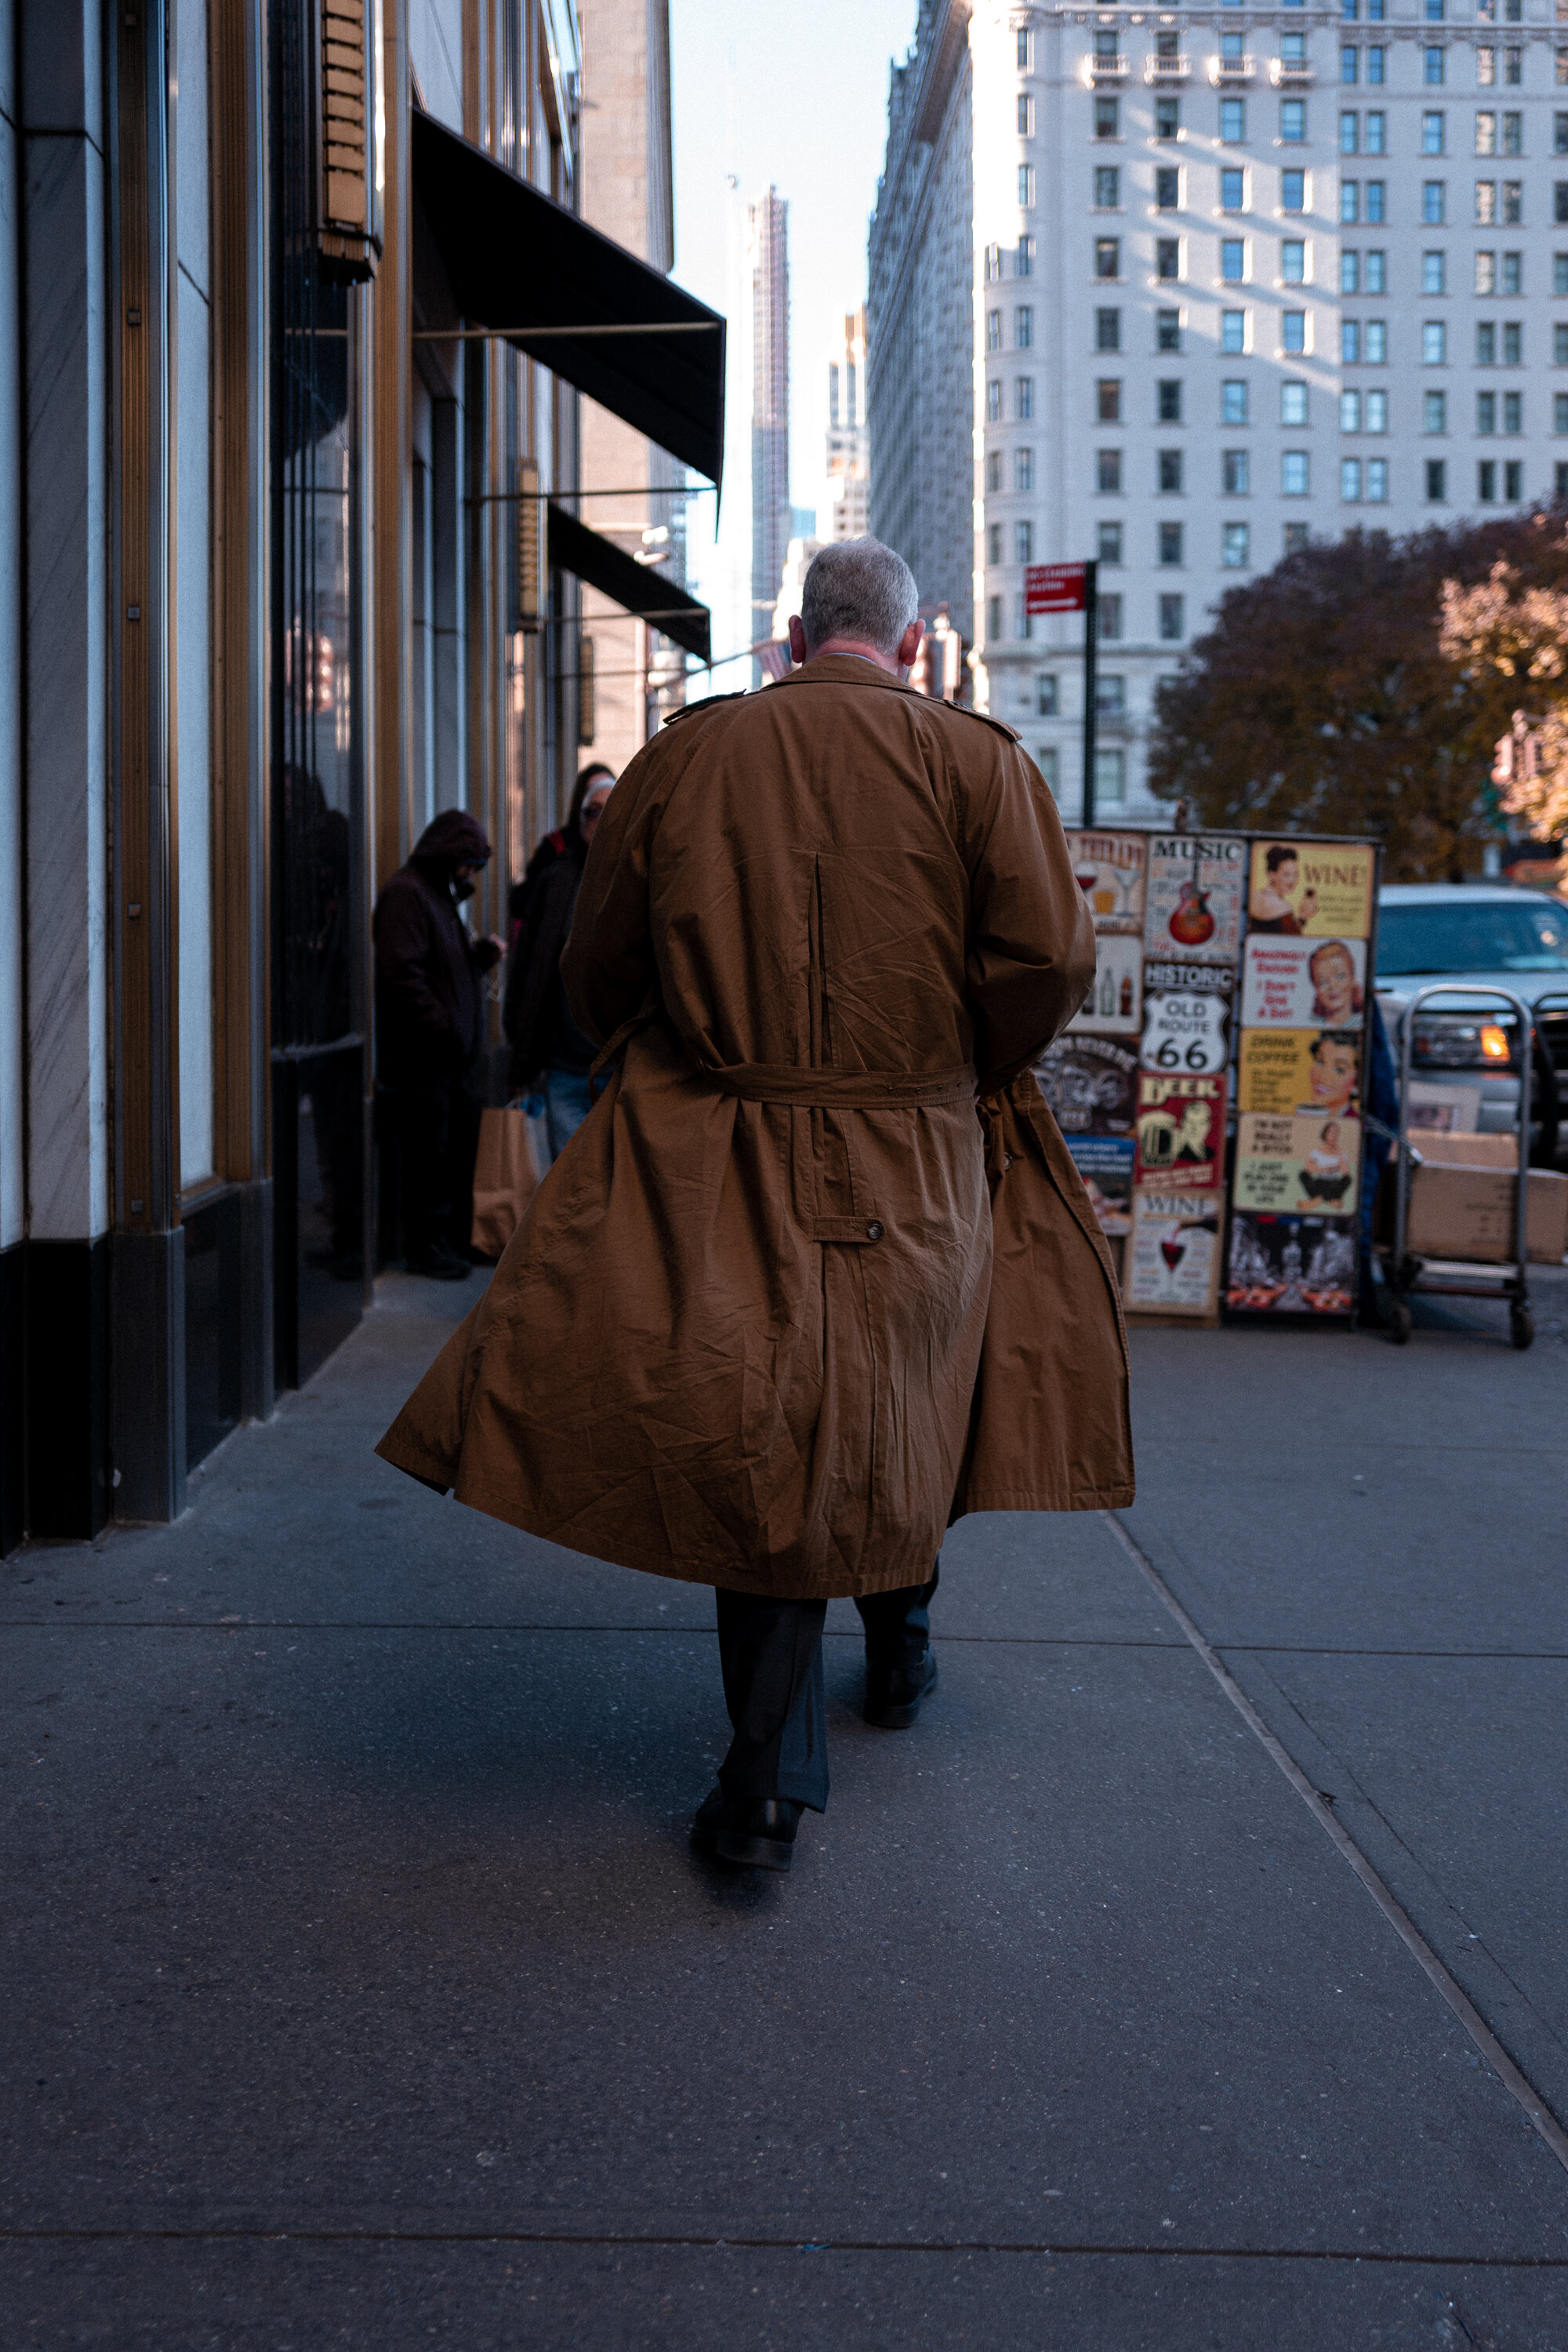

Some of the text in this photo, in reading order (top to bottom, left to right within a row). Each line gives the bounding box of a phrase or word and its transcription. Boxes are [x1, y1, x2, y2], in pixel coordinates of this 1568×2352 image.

[1154, 840, 1242, 860] MUSIC
[1145, 963, 1233, 987] HISTORIC
[1167, 1000, 1207, 1018] OLD
[1158, 1018, 1210, 1033] ROUTE
[1251, 1035, 1295, 1047] DRINK
[1157, 1038, 1207, 1069] 66
[1247, 1051, 1298, 1064] COFFEE
[1141, 1076, 1221, 1107] BEER
[1144, 1194, 1214, 1217] WINE
